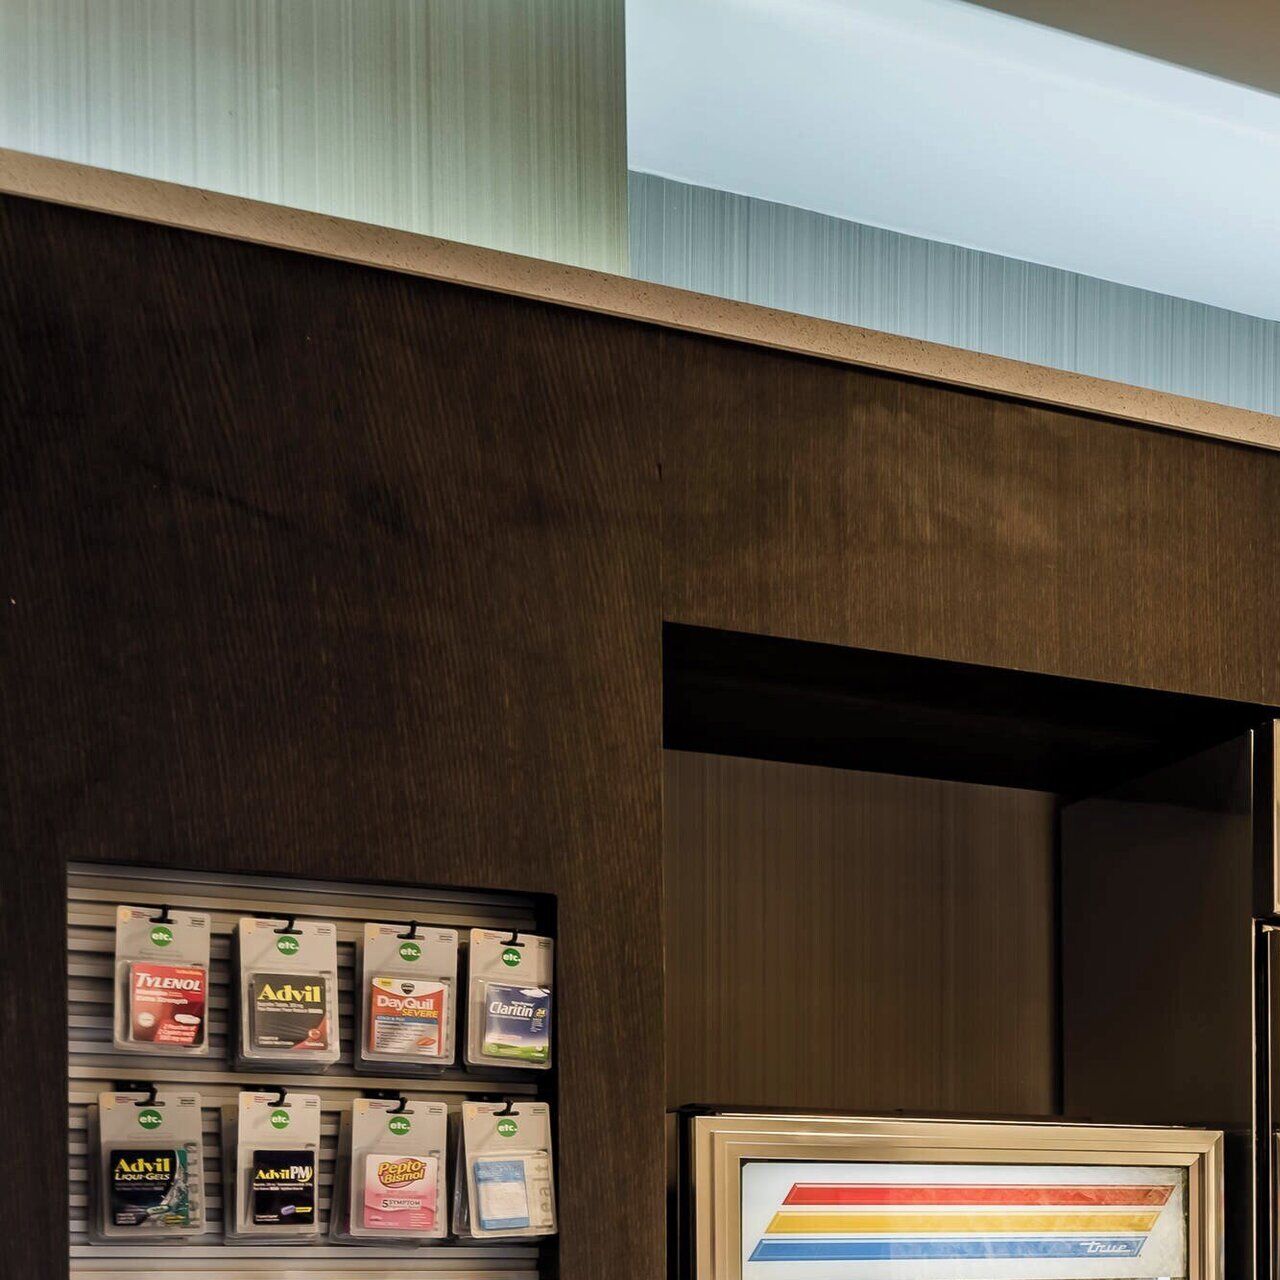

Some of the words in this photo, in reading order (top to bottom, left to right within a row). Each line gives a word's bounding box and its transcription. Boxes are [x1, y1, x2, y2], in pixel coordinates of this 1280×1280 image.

[151, 931, 173, 941] etc.
[277, 940, 299, 950] etc.
[400, 947, 421, 956] etc.
[502, 953, 521, 962] etc.
[135, 972, 203, 992] TYLENOL
[257, 984, 323, 1002] Advil
[377, 995, 434, 1011] DayQuil
[402, 1009, 438, 1019] SEVERE
[489, 1001, 534, 1018] Claritin
[139, 1115, 162, 1124] etc.
[271, 1115, 290, 1124] etc.
[389, 1122, 410, 1130] etc.
[498, 1124, 518, 1132] etc.
[115, 1157, 171, 1173] Advil
[378, 1160, 426, 1176] Pepto-
[114, 1172, 171, 1181] LIQUI-GELS
[382, 1168, 424, 1184] Bismol
